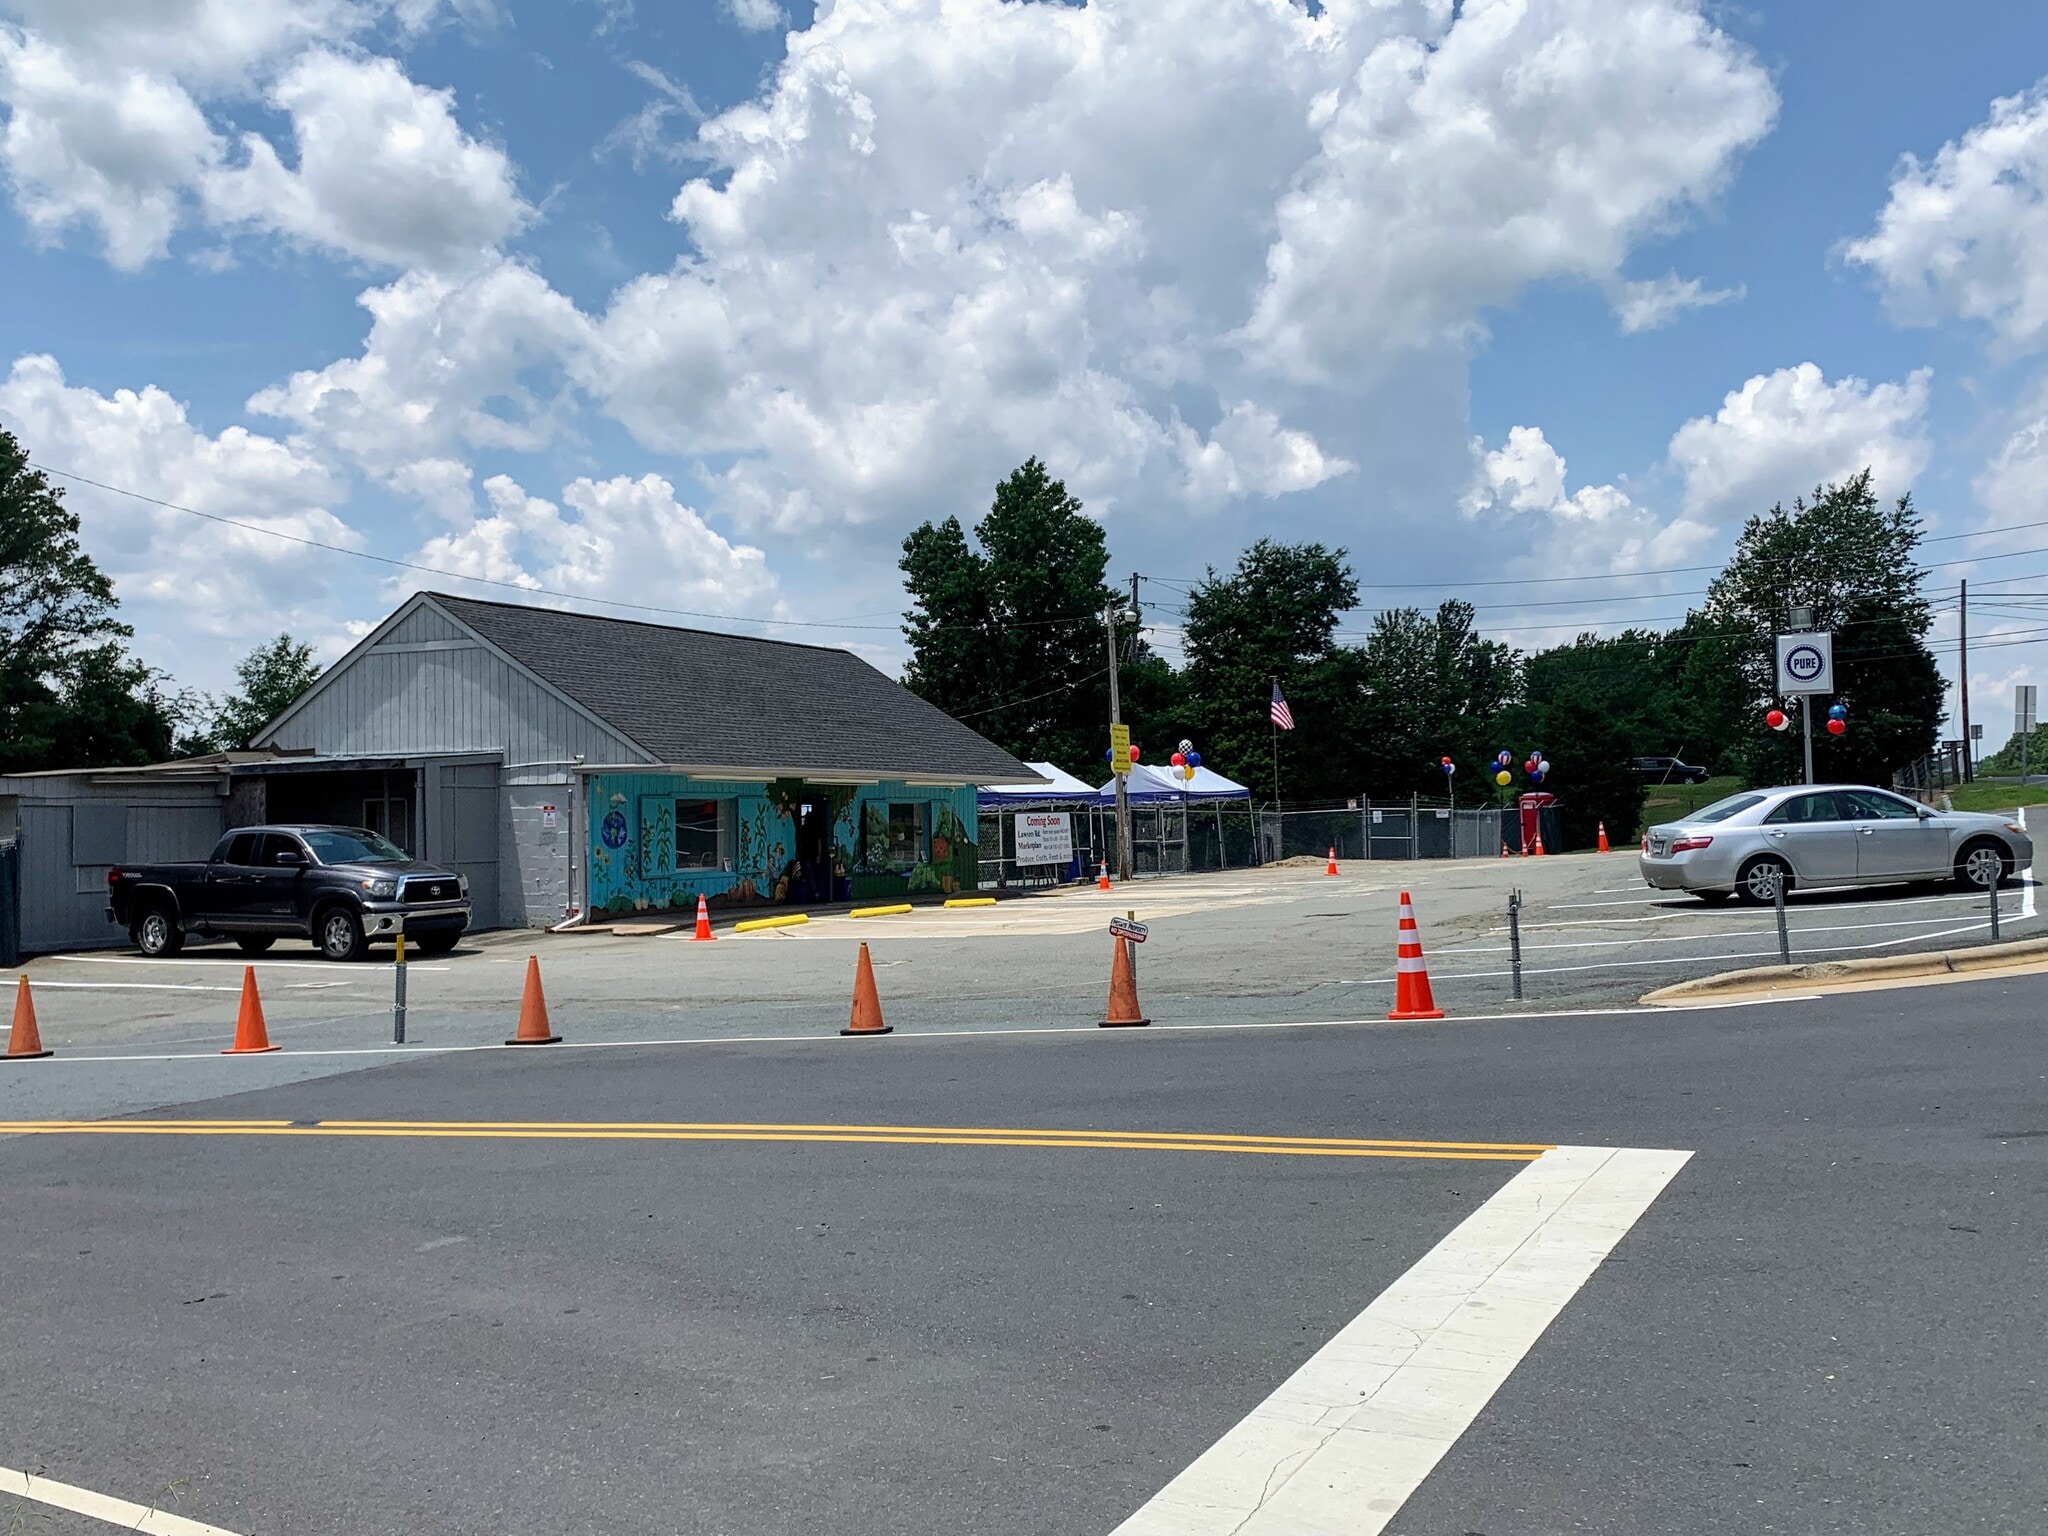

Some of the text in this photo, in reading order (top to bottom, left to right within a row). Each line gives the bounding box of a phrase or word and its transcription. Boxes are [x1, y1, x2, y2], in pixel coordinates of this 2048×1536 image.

[1794, 658, 1815, 669] PURE
[1027, 815, 1060, 828] Coming Soon
